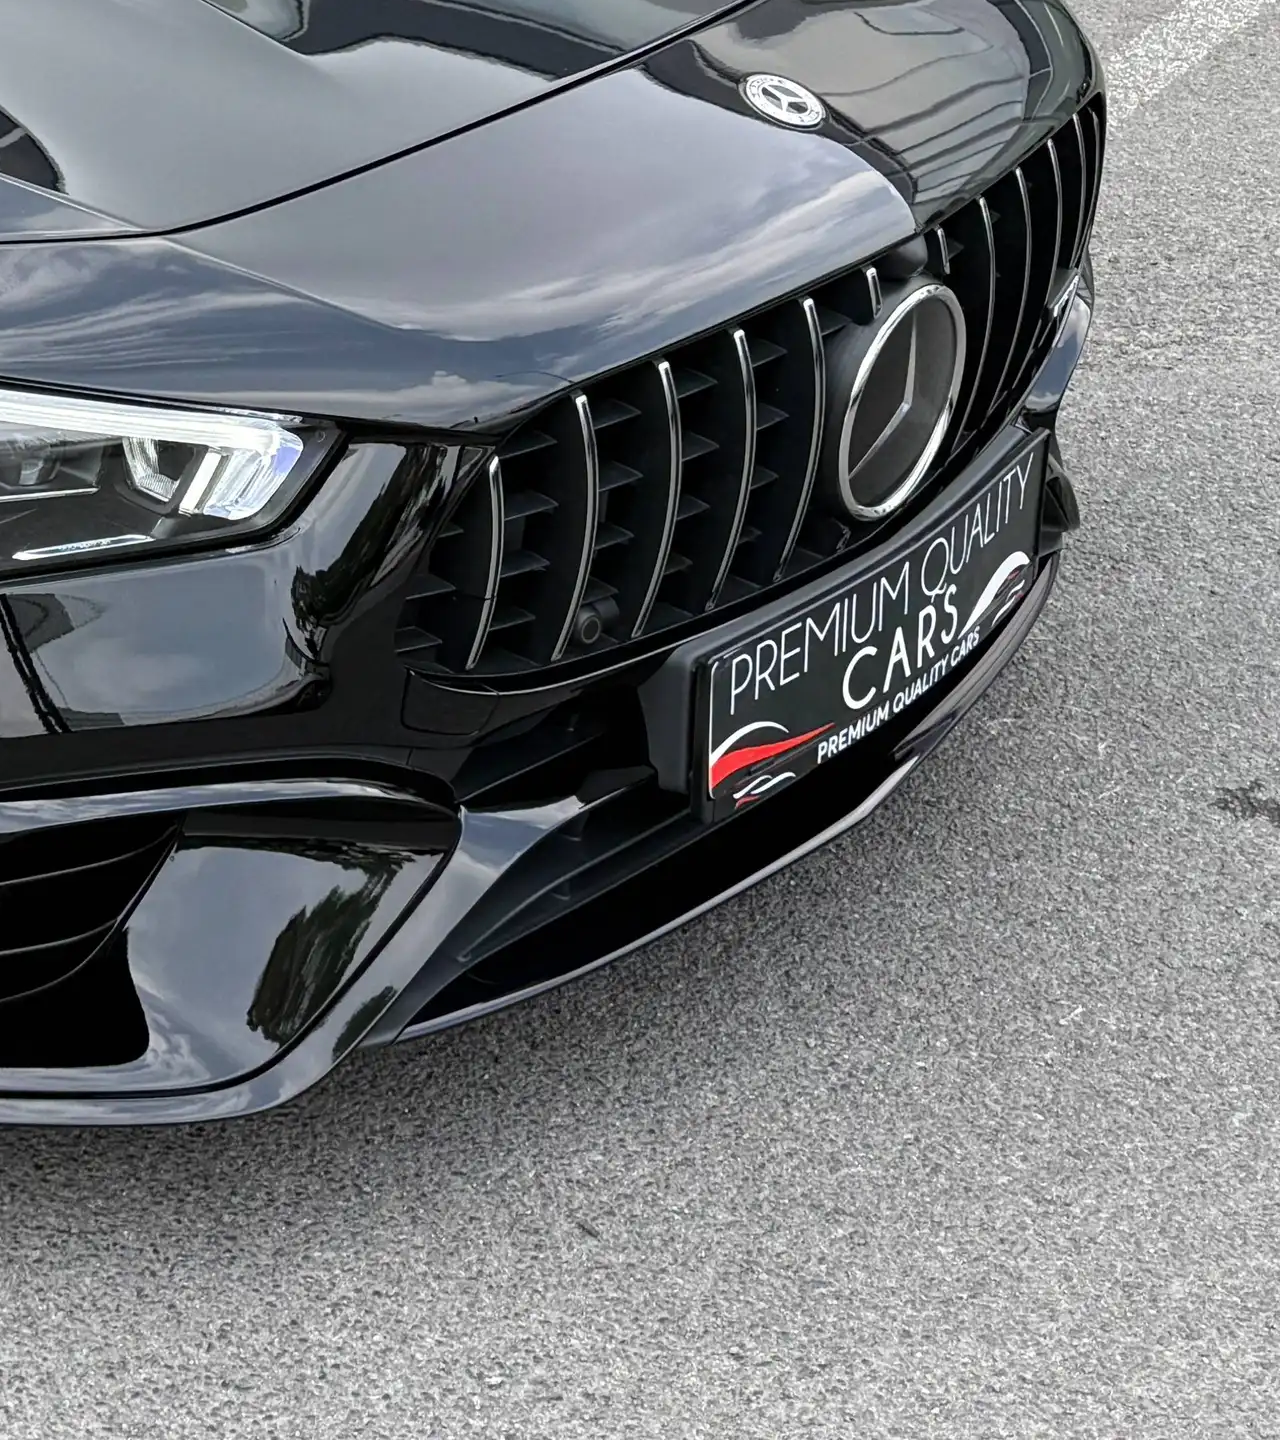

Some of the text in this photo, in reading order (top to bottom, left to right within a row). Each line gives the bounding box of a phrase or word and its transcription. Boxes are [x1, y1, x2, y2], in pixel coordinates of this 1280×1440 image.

[730, 452, 1035, 715] PREMIUM QUALITY
[842, 582, 960, 711] CARS
[816, 627, 981, 765] PREMIUM QUALITY CARS
